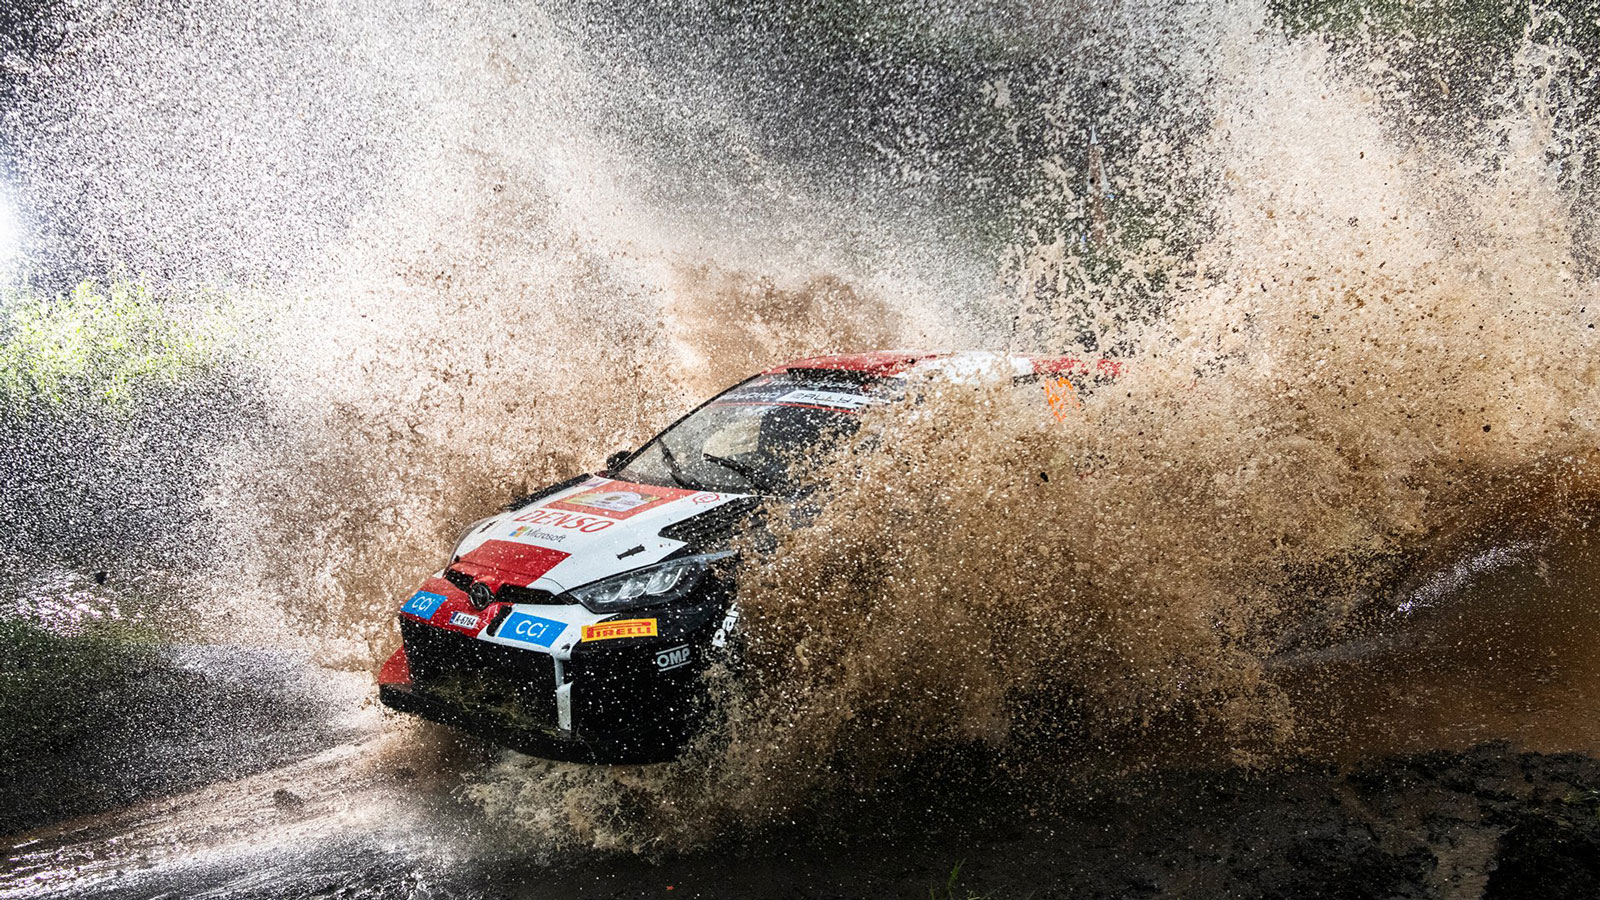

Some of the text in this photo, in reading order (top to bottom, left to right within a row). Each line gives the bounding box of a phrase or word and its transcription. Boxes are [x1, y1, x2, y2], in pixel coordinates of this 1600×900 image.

[513, 510, 615, 533] DENSO
[523, 528, 567, 543] Microsoft
[515, 619, 549, 639] CCi
[586, 621, 652, 639] PIRELLI
[656, 648, 691, 668] OMP
